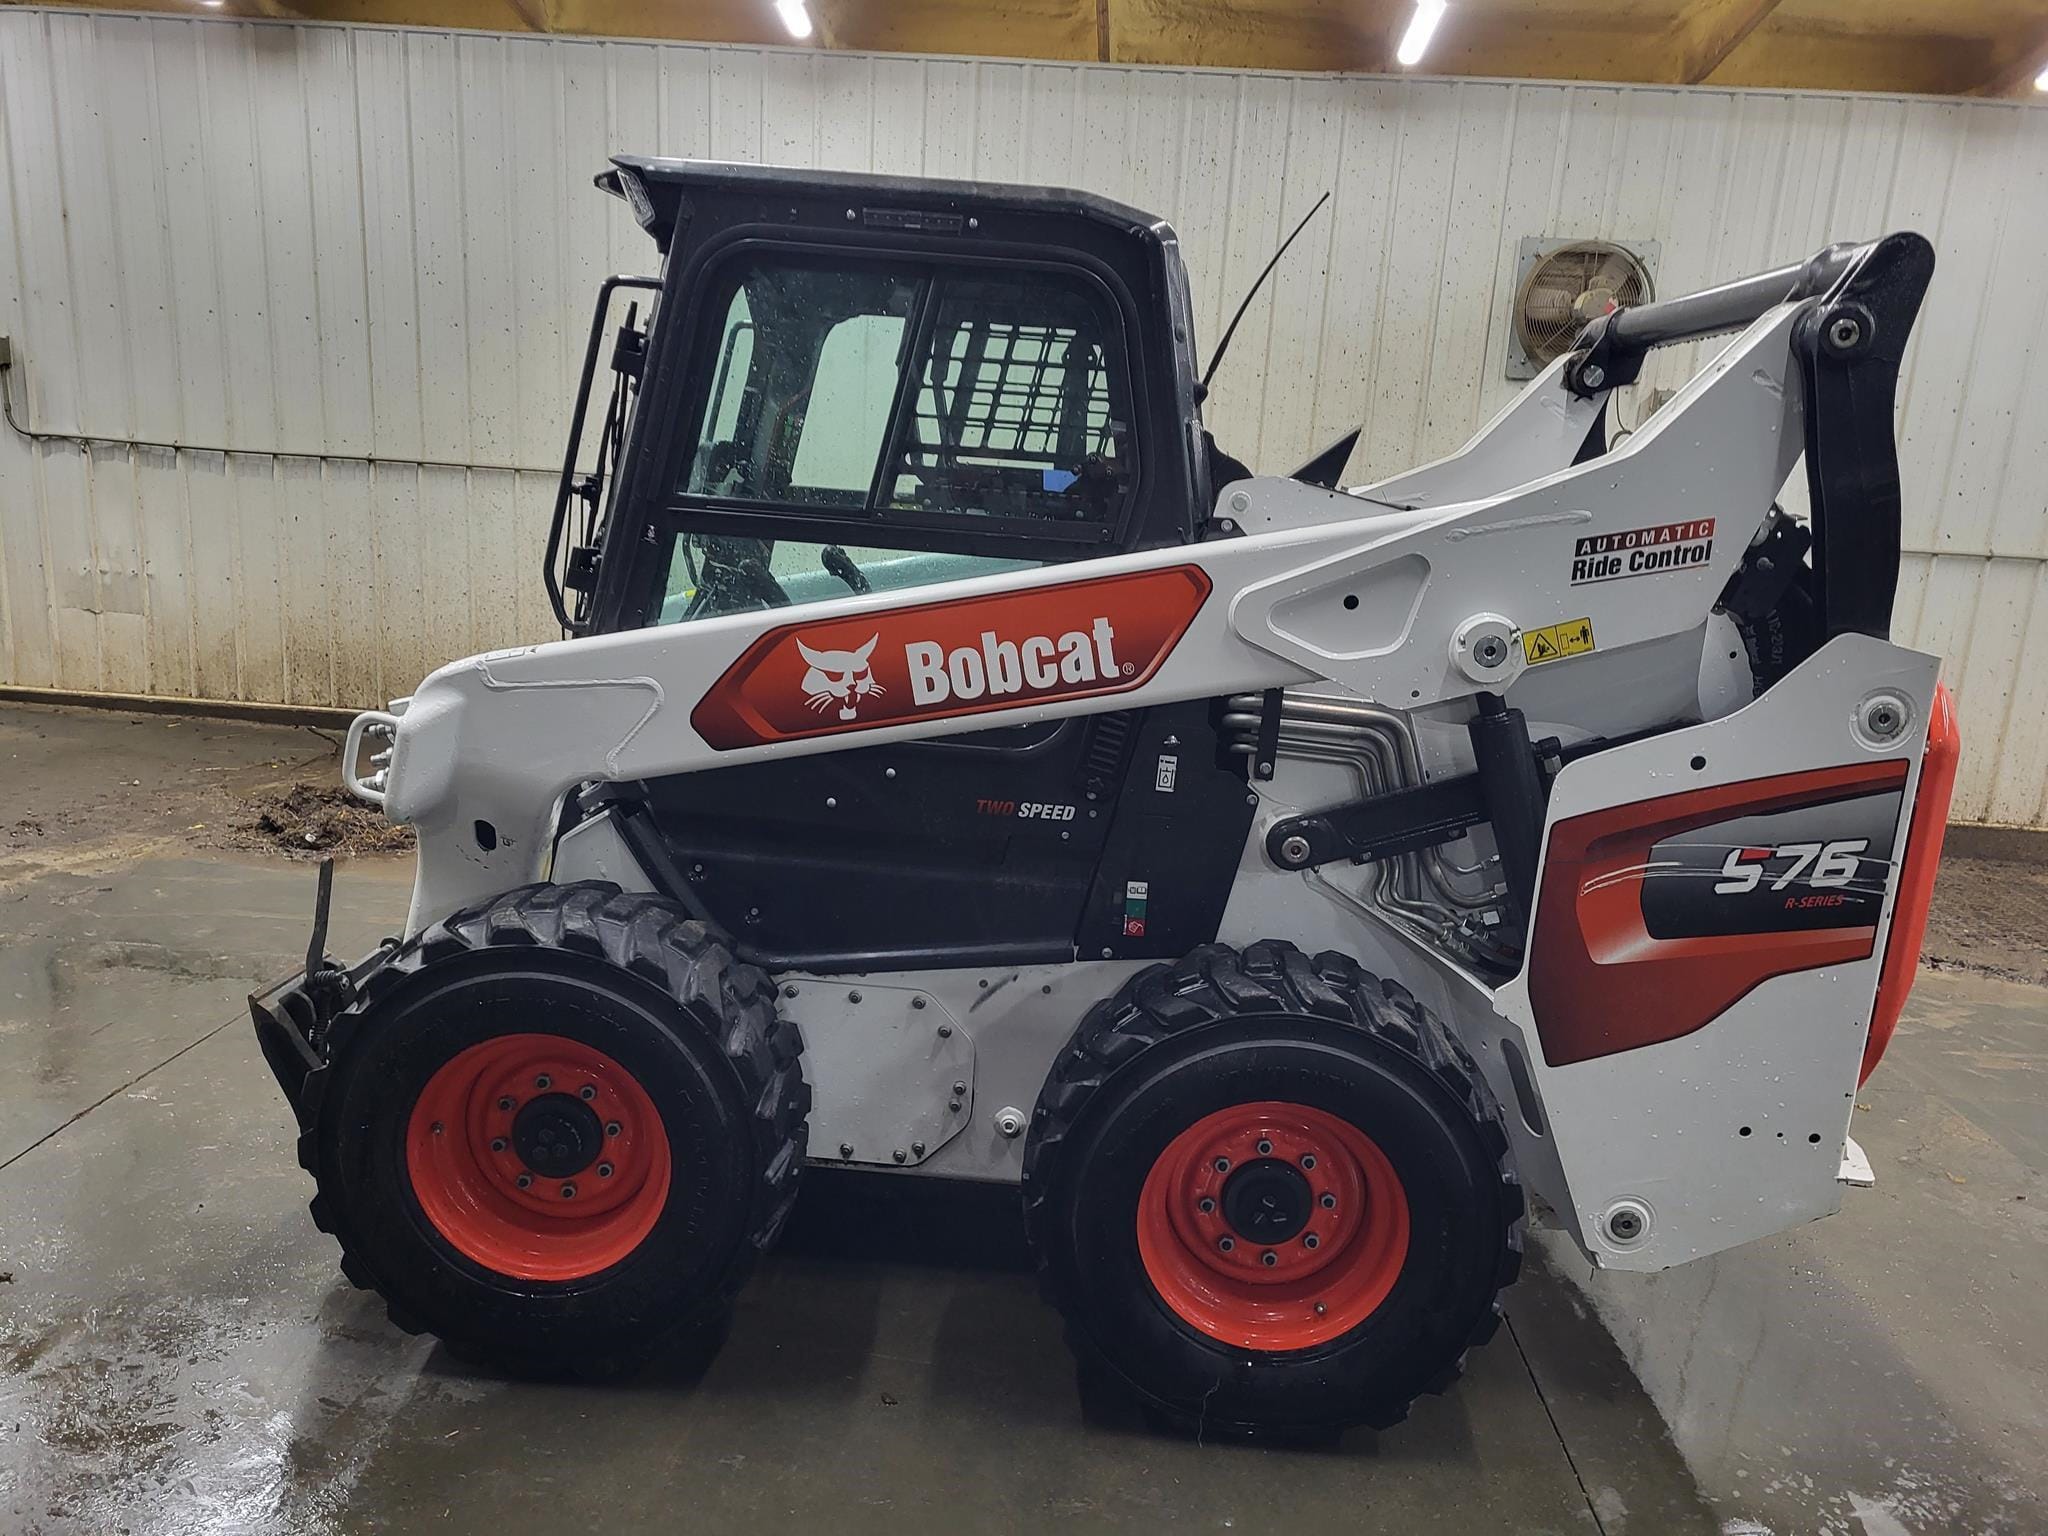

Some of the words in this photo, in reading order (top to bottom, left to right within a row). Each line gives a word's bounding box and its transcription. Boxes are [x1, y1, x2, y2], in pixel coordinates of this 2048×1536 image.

[1580, 521, 1709, 555] AUTOMATIC
[1571, 556, 1622, 581] Ride
[1628, 540, 1713, 572] Control
[976, 799, 1016, 816] TWO
[1017, 802, 1076, 821] SPEED
[1713, 839, 1869, 895] S76
[1784, 894, 1845, 909] R-SERIES
